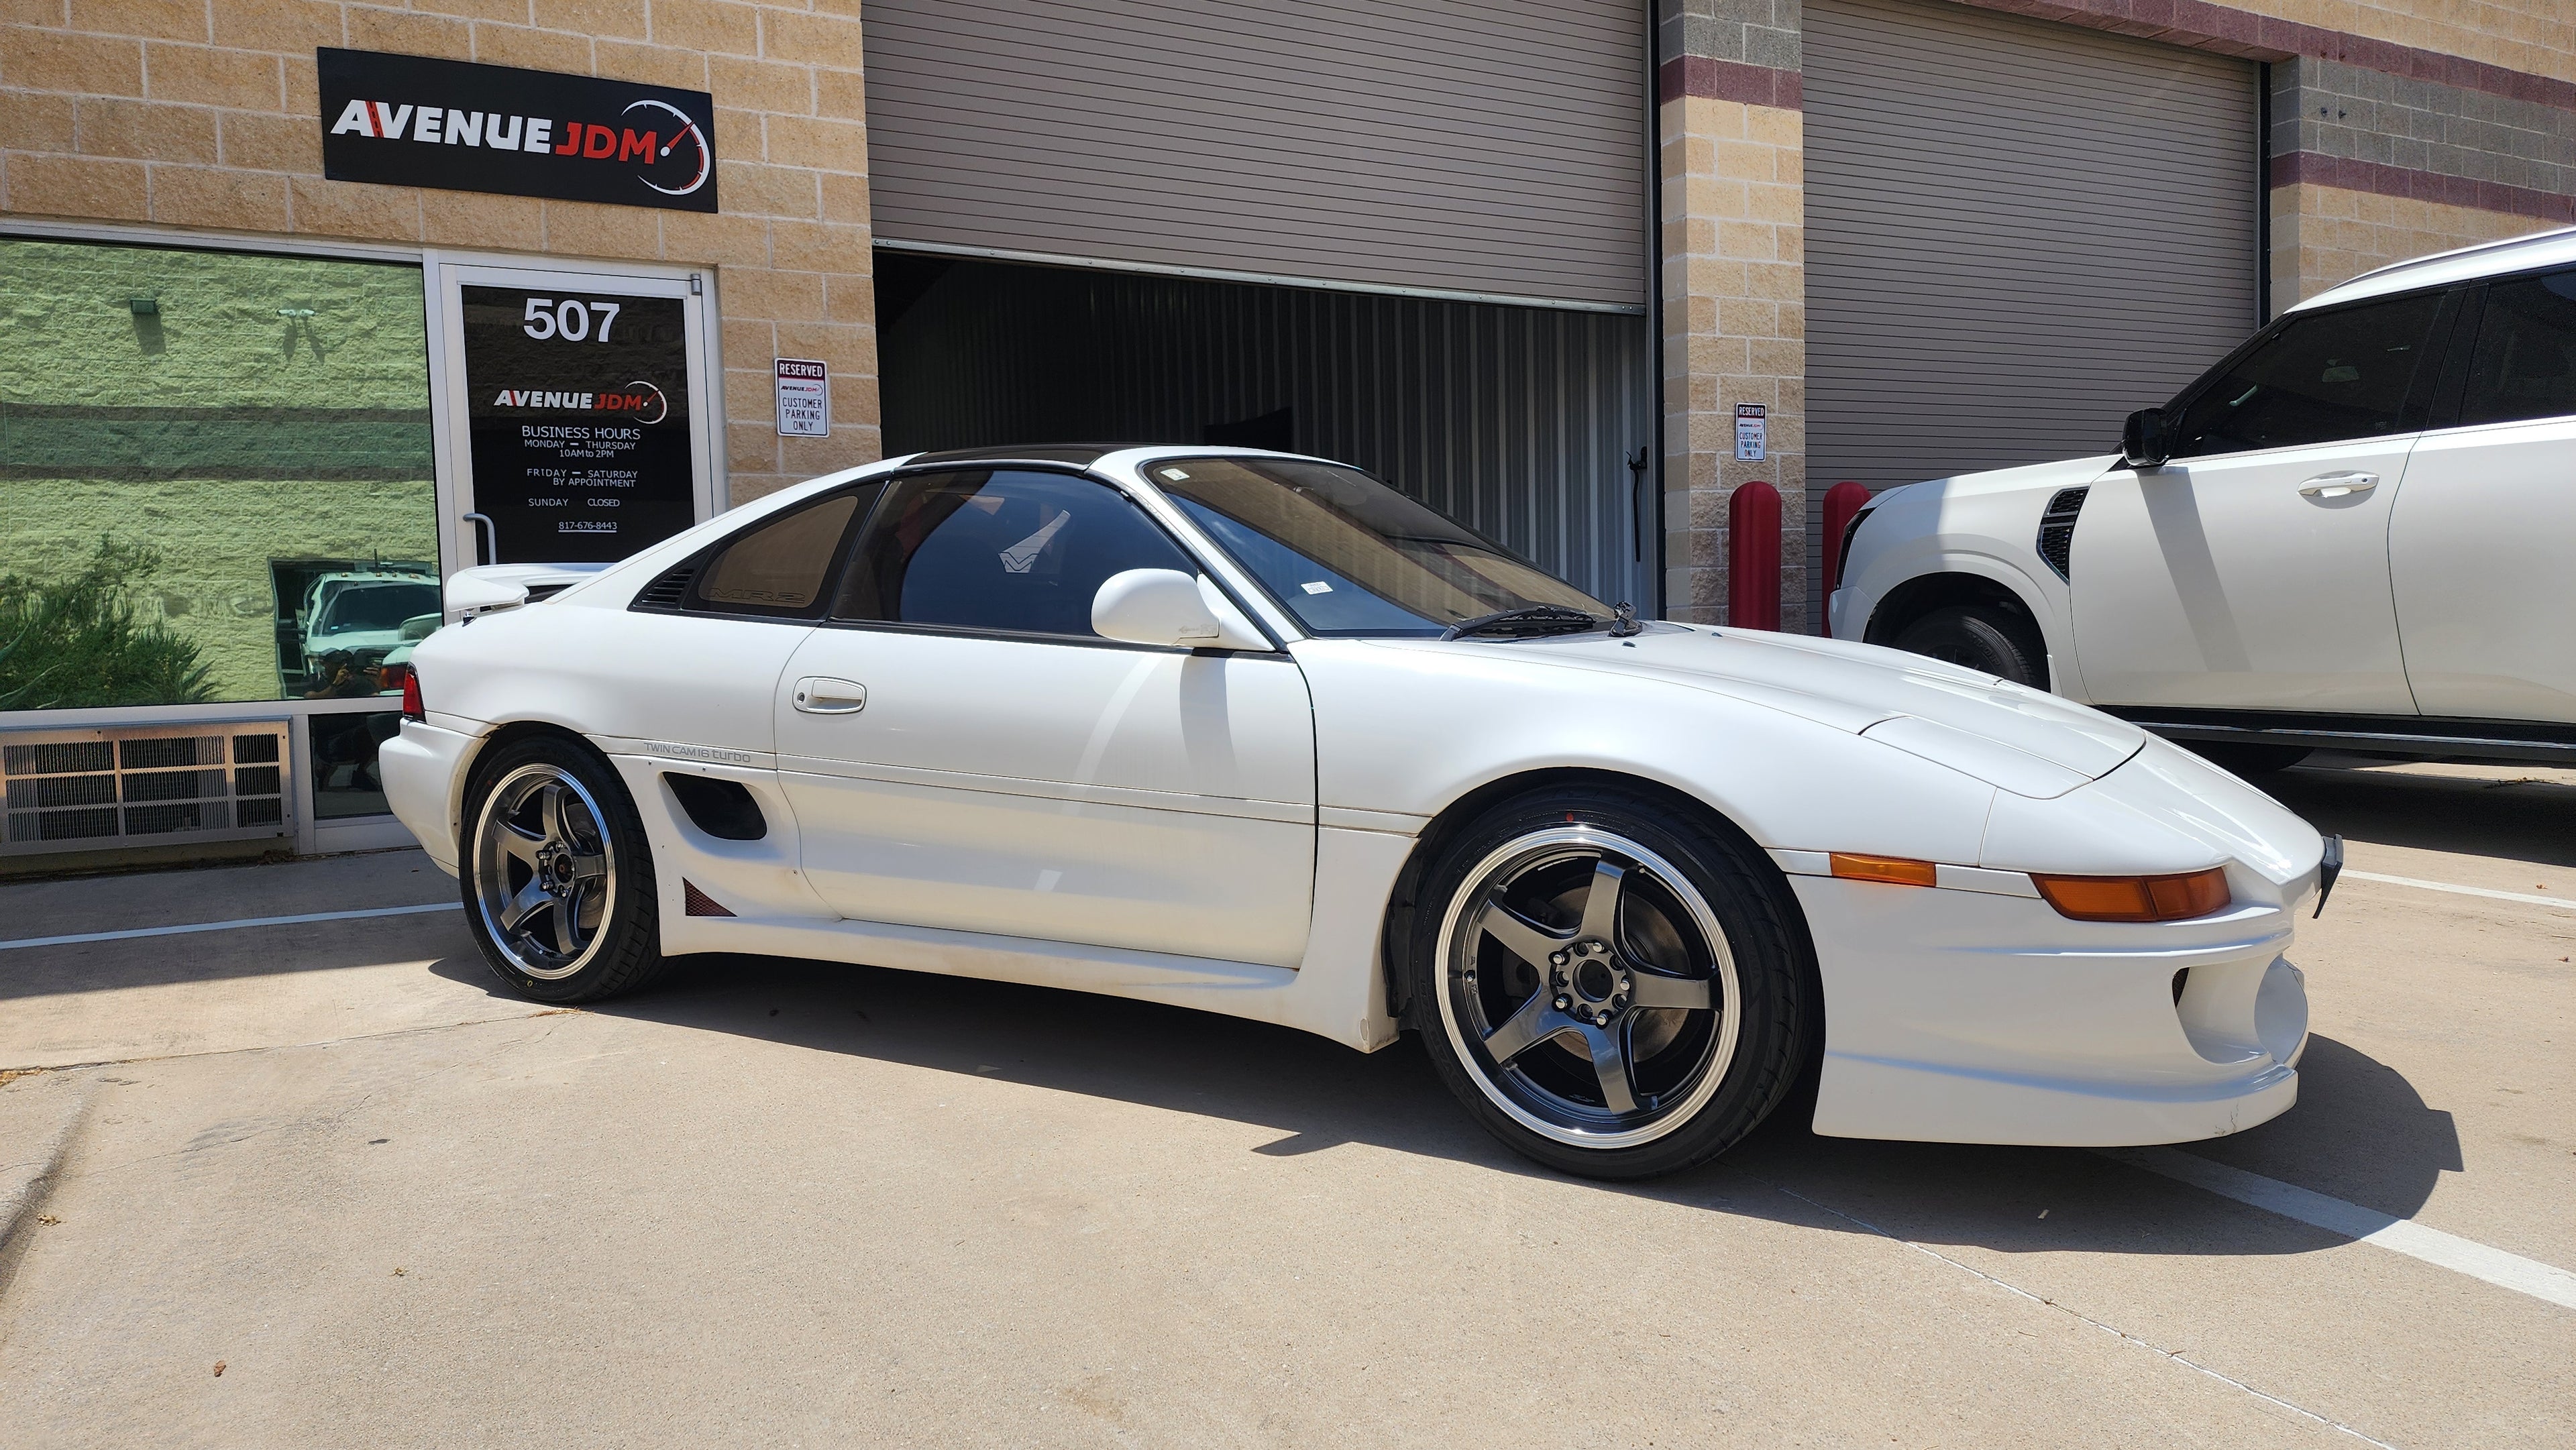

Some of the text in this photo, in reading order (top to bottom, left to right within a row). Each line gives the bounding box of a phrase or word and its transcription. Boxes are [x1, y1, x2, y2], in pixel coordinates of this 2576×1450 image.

[523, 298, 620, 342] 507
[779, 363, 823, 378] RESERVED
[782, 397, 822, 409] CUSTOMER
[786, 408, 820, 421] PARKING
[1739, 406, 1764, 416] RESERVED
[793, 421, 814, 431] ONLY
[522, 425, 641, 440] BUSINESS HOURS
[1739, 432, 1763, 440] CUSTOMER
[525, 439, 566, 448] MONDAY
[585, 441, 637, 450] THURSDAY
[1741, 441, 1761, 449] PARKING
[559, 449, 584, 457] 10AM
[596, 450, 614, 458] 2PM
[1745, 449, 1756, 457] ONLY
[527, 469, 567, 477] FRIDAY
[587, 469, 639, 478] SATURDAY
[553, 478, 637, 488] BY APPOINTMENT
[528, 498, 621, 507] SUNDAY CLOSED
[558, 521, 618, 531] 817-676-8443
[706, 588, 805, 604] MR2
[644, 742, 751, 763] TWIN CAM 16 turbo
